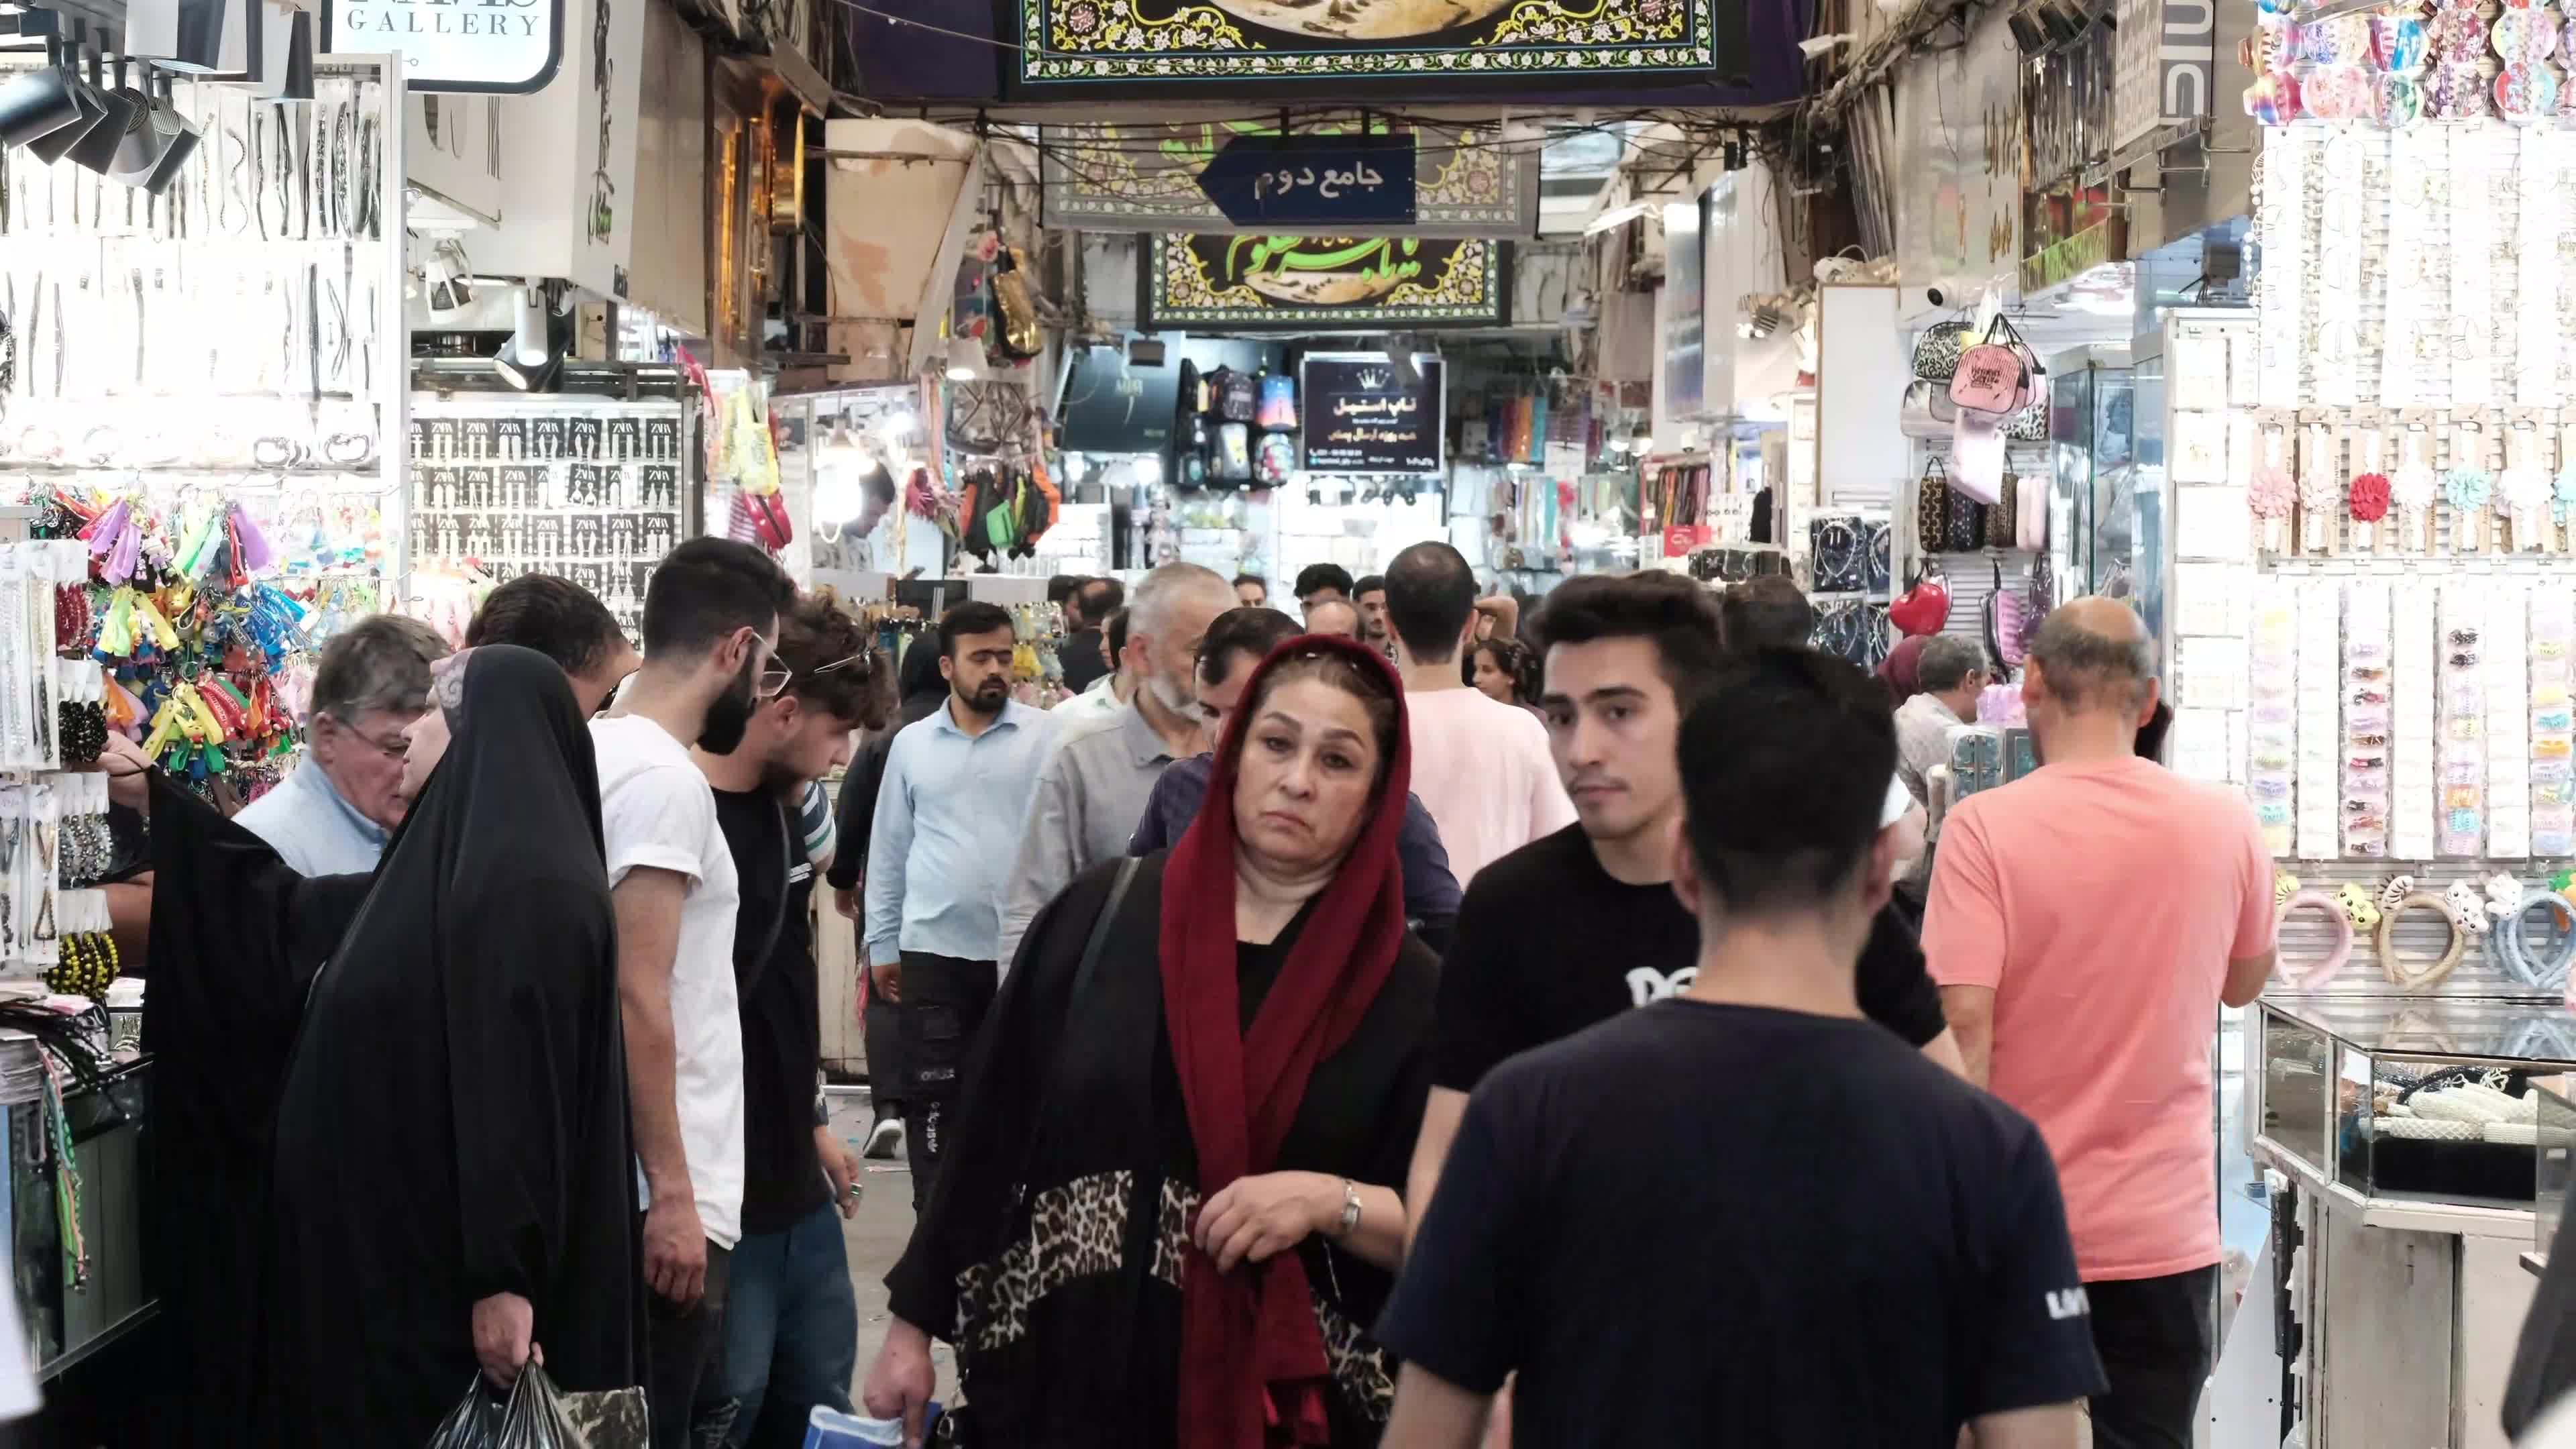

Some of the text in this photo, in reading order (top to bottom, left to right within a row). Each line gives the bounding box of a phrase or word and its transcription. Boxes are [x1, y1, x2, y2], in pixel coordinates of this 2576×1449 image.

[347, 9, 539, 36] GALLERY
[1254, 161, 1384, 200] جامع دوم
[499, 423, 521, 433] ZARA
[537, 423, 559, 433] ZARA
[575, 422, 596, 433] ZARA
[612, 423, 633, 433] ZARA
[651, 423, 671, 433] ZARA
[649, 470, 669, 480] ZARA
[576, 519, 598, 530] ZARA
[612, 519, 633, 529] ZARA
[647, 517, 668, 528] ZARA
[617, 615, 635, 626] ARA
